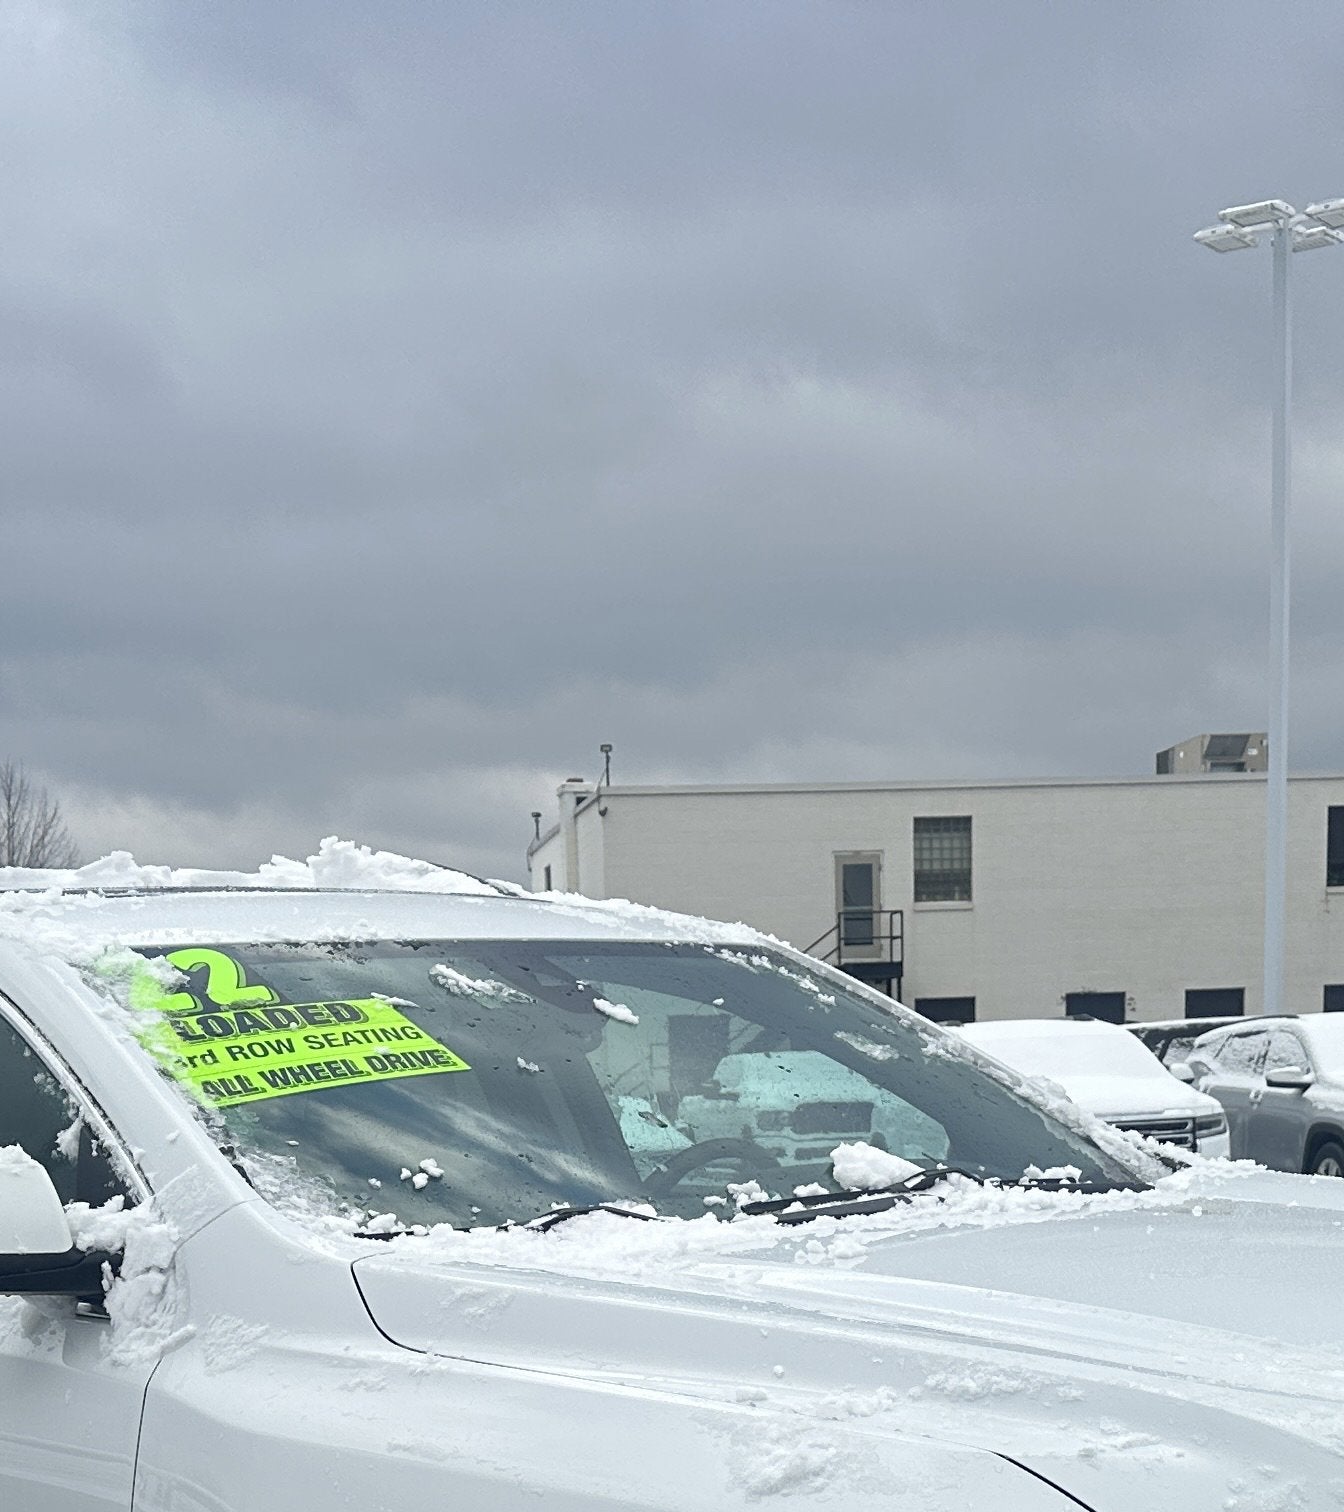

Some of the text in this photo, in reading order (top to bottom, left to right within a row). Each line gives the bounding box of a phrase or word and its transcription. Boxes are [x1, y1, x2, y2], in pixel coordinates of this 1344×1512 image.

[170, 1002, 369, 1043] LOADED
[225, 1037, 296, 1062] ROW
[302, 1026, 424, 1050] SEATING
[201, 1048, 458, 1099] ALL WHEEL DRIVE
